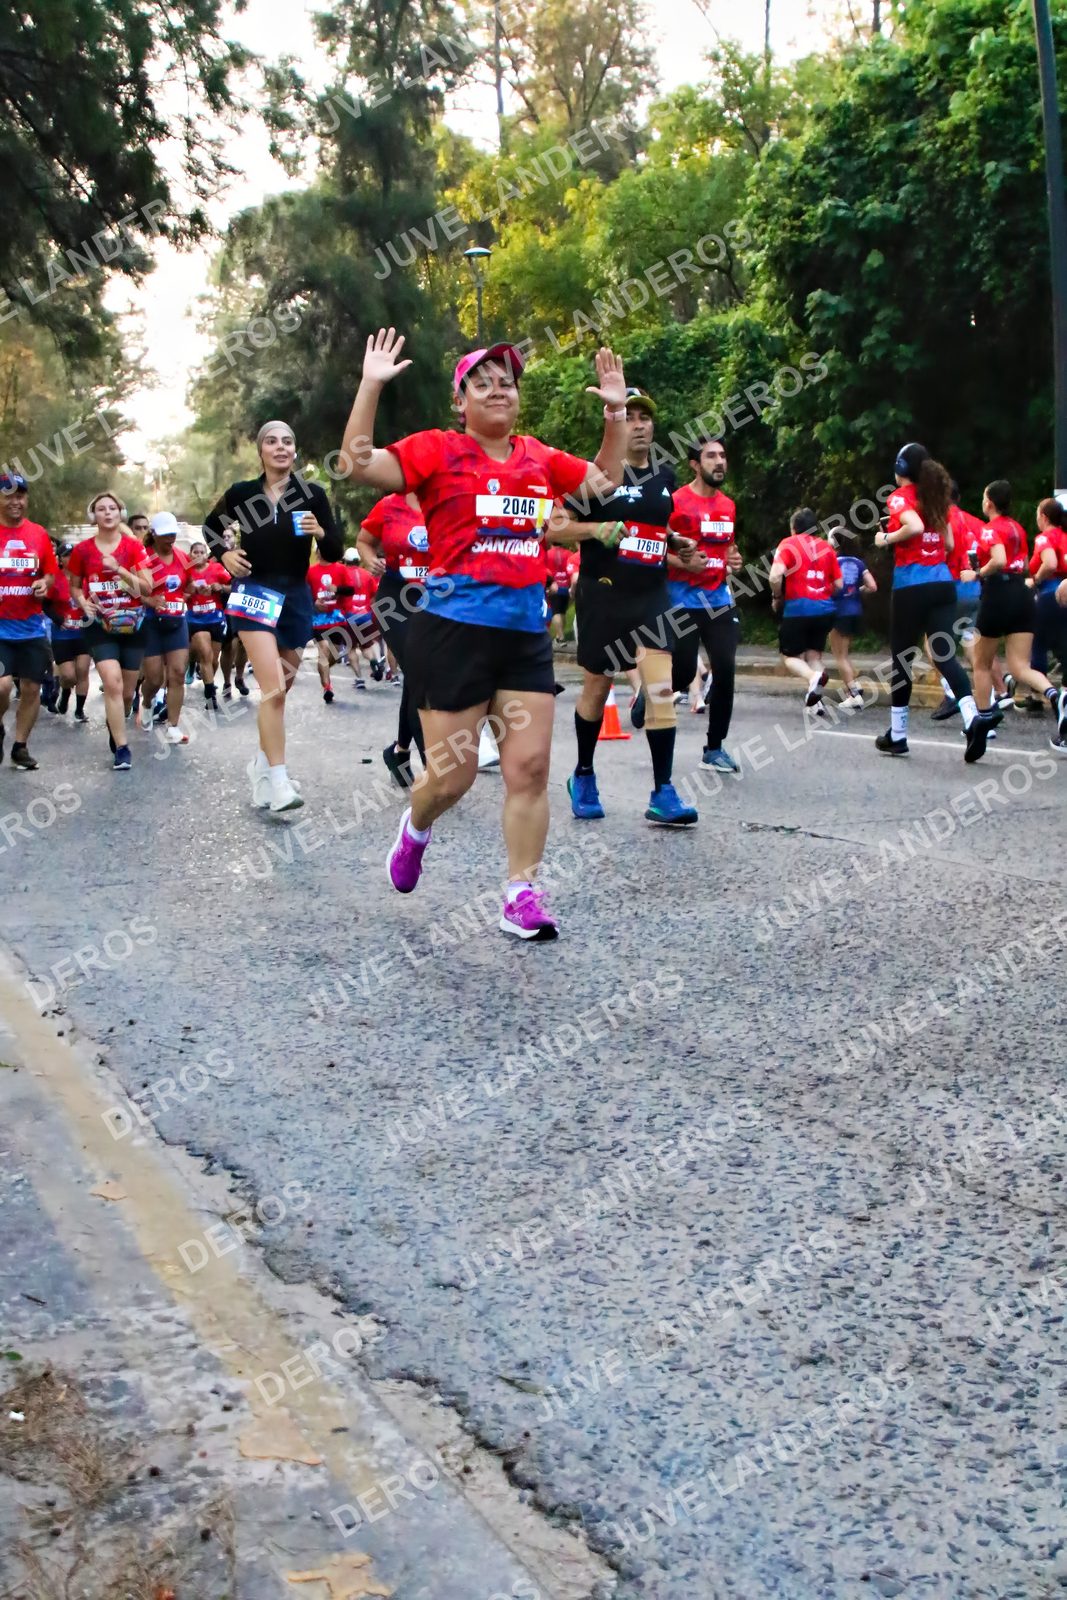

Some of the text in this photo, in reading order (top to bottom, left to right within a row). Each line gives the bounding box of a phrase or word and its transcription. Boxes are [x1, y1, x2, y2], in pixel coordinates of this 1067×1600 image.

[502, 498, 535, 516] 2046
[471, 537, 540, 557] SANTIAGO
[637, 539, 660, 553] 17619
[241, 595, 265, 611] 5685
